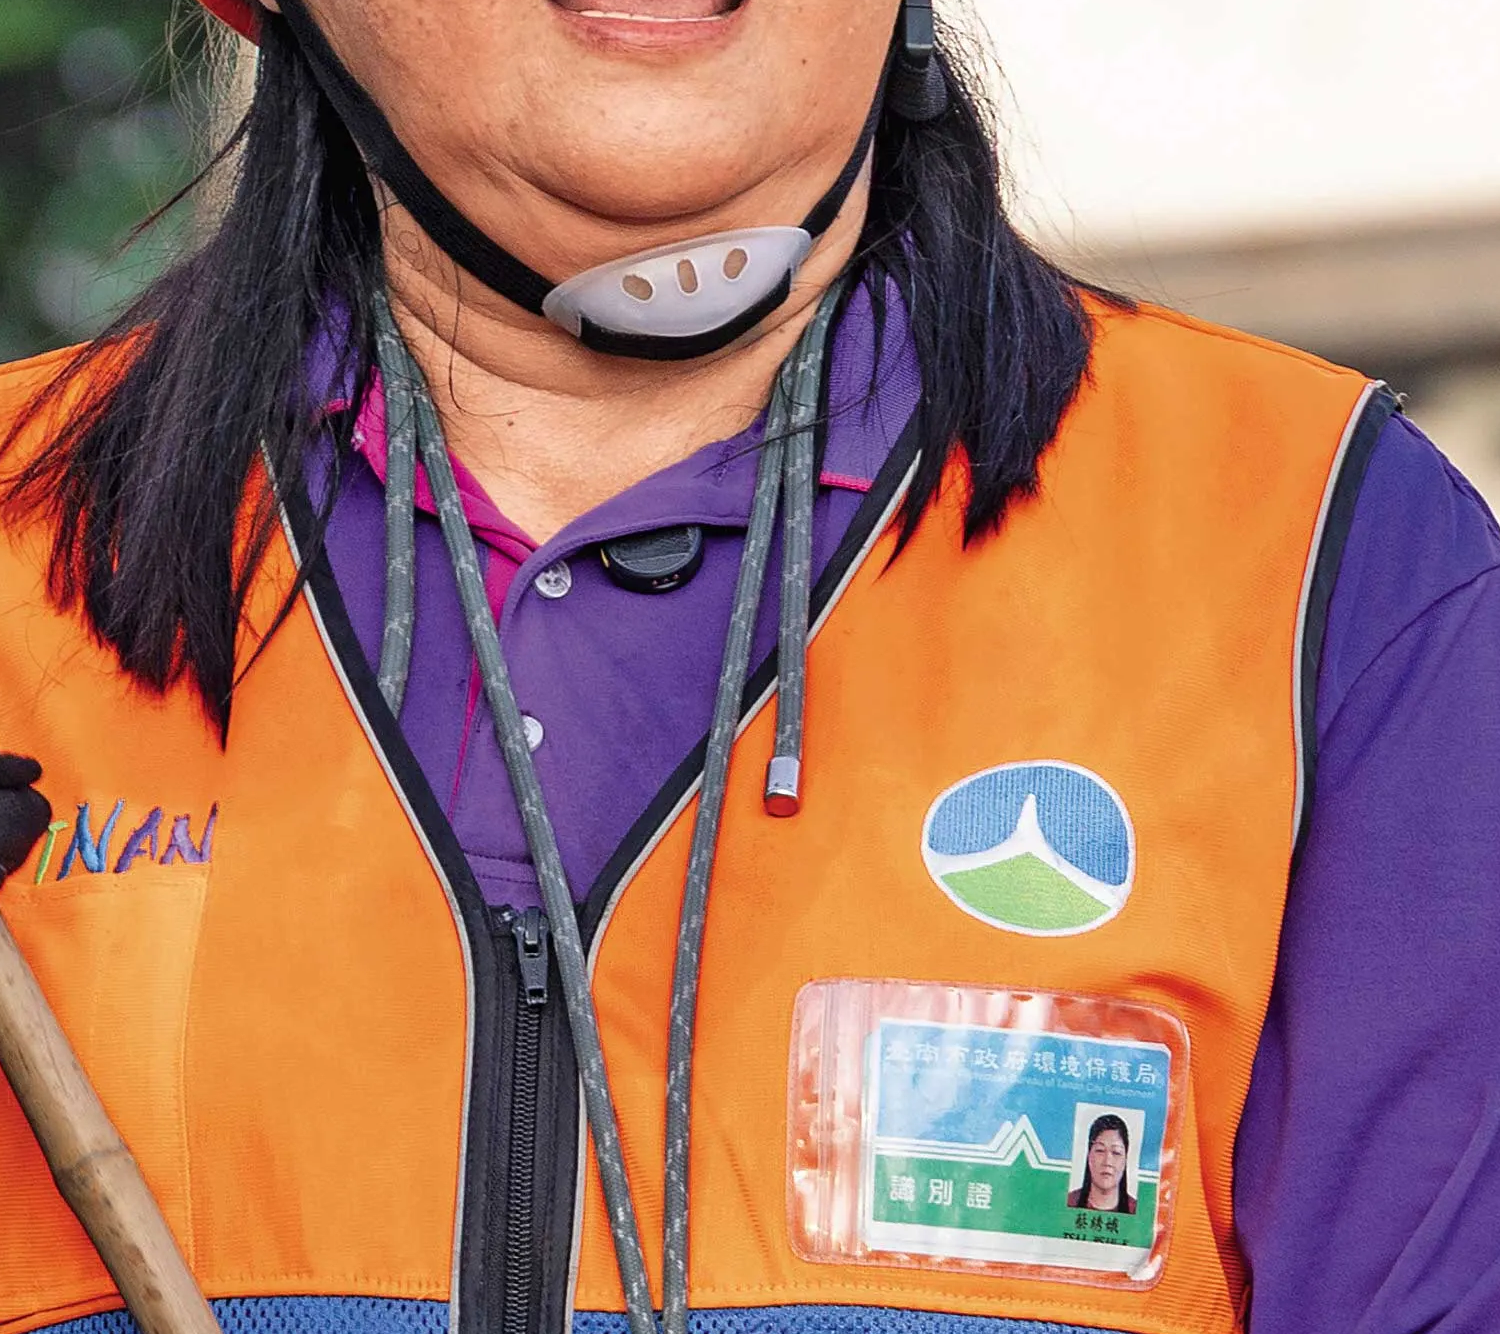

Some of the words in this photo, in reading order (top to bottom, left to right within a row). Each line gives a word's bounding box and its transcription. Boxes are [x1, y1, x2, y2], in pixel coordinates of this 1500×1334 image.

[34, 797, 219, 886] INAN
[890, 1175, 992, 1209] 識別證
